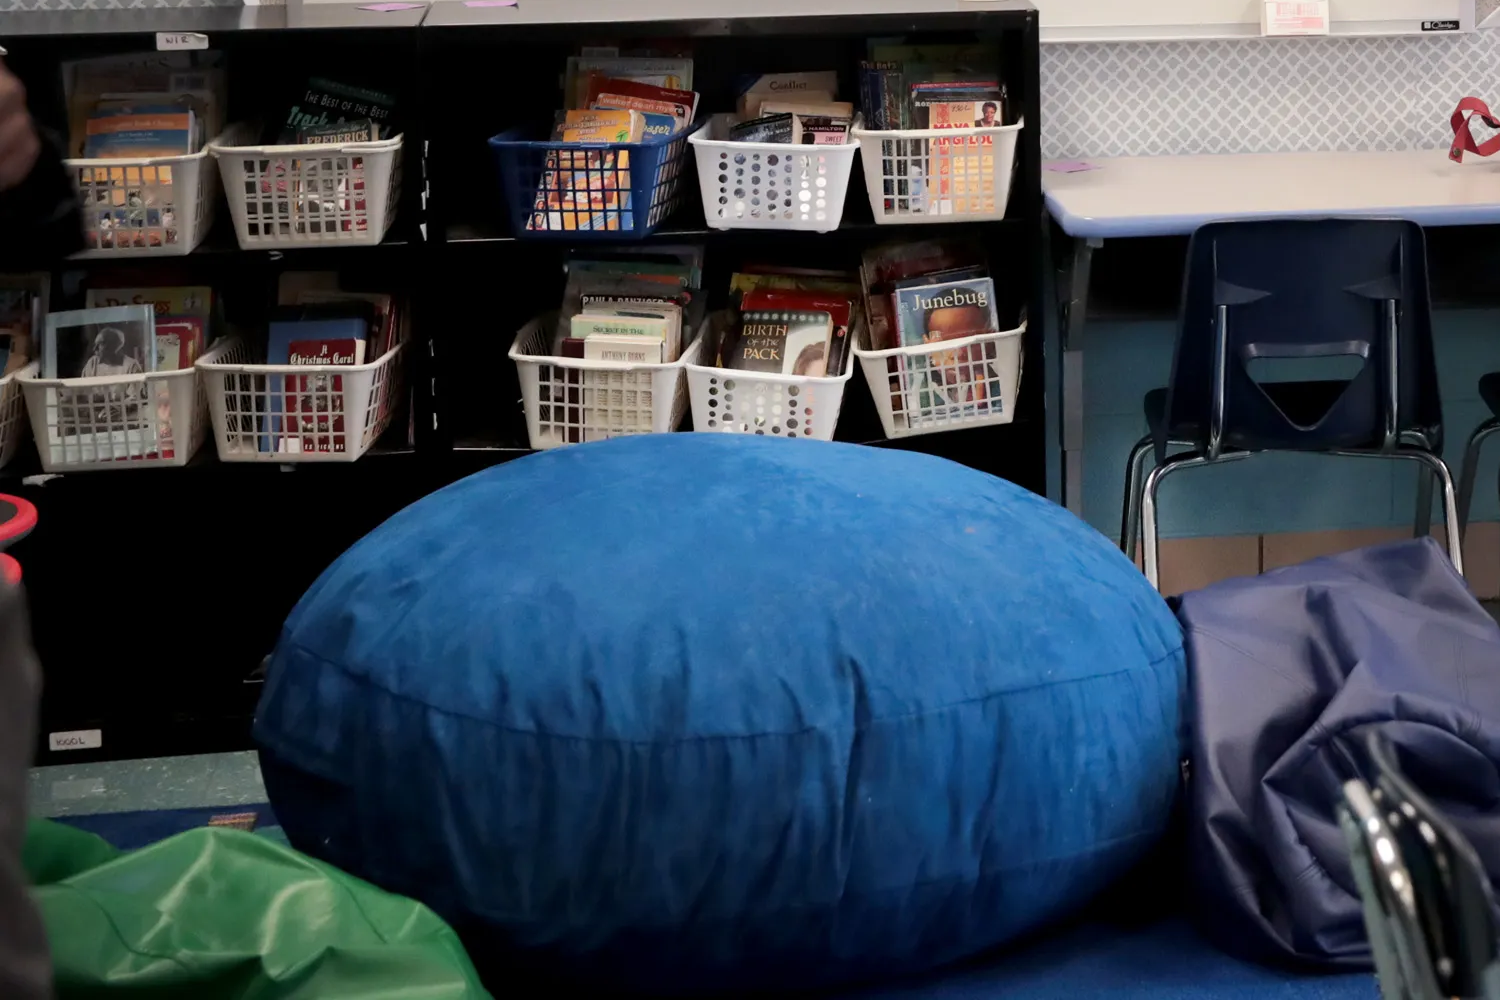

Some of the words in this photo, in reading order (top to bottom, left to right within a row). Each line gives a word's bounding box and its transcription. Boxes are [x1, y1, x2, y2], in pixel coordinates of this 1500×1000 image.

[306, 129, 369, 145] FREDERICK
[912, 288, 988, 312] Junebug
[742, 324, 788, 336] BIRTH
[747, 338, 759, 347] of
[290, 352, 331, 366] Christmas
[742, 347, 781, 360] PACK
